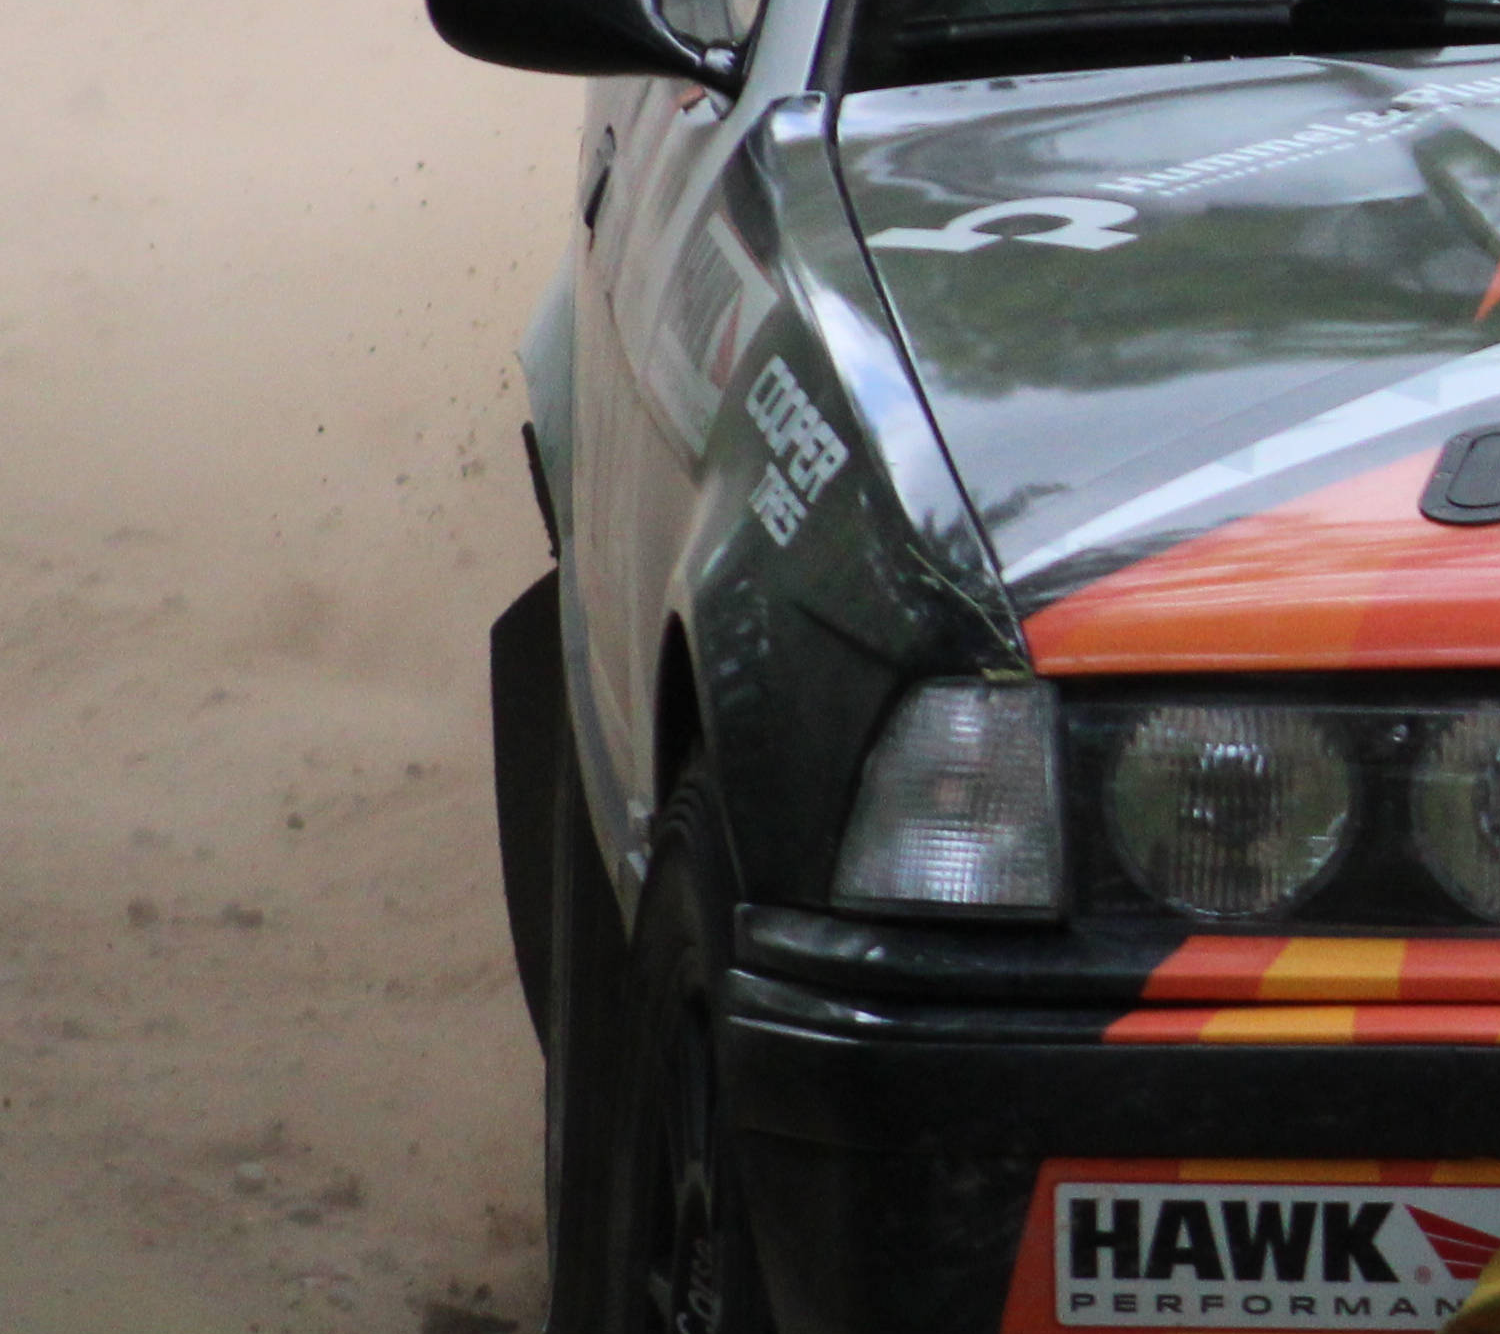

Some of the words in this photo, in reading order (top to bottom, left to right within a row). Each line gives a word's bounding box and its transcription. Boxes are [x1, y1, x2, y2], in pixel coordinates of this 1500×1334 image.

[1098, 122, 1351, 195] Hummel
[746, 355, 850, 503] COOPER
[1069, 1198, 1400, 1283] HAWK
[1070, 1292, 1464, 1318] PERFORMAN
